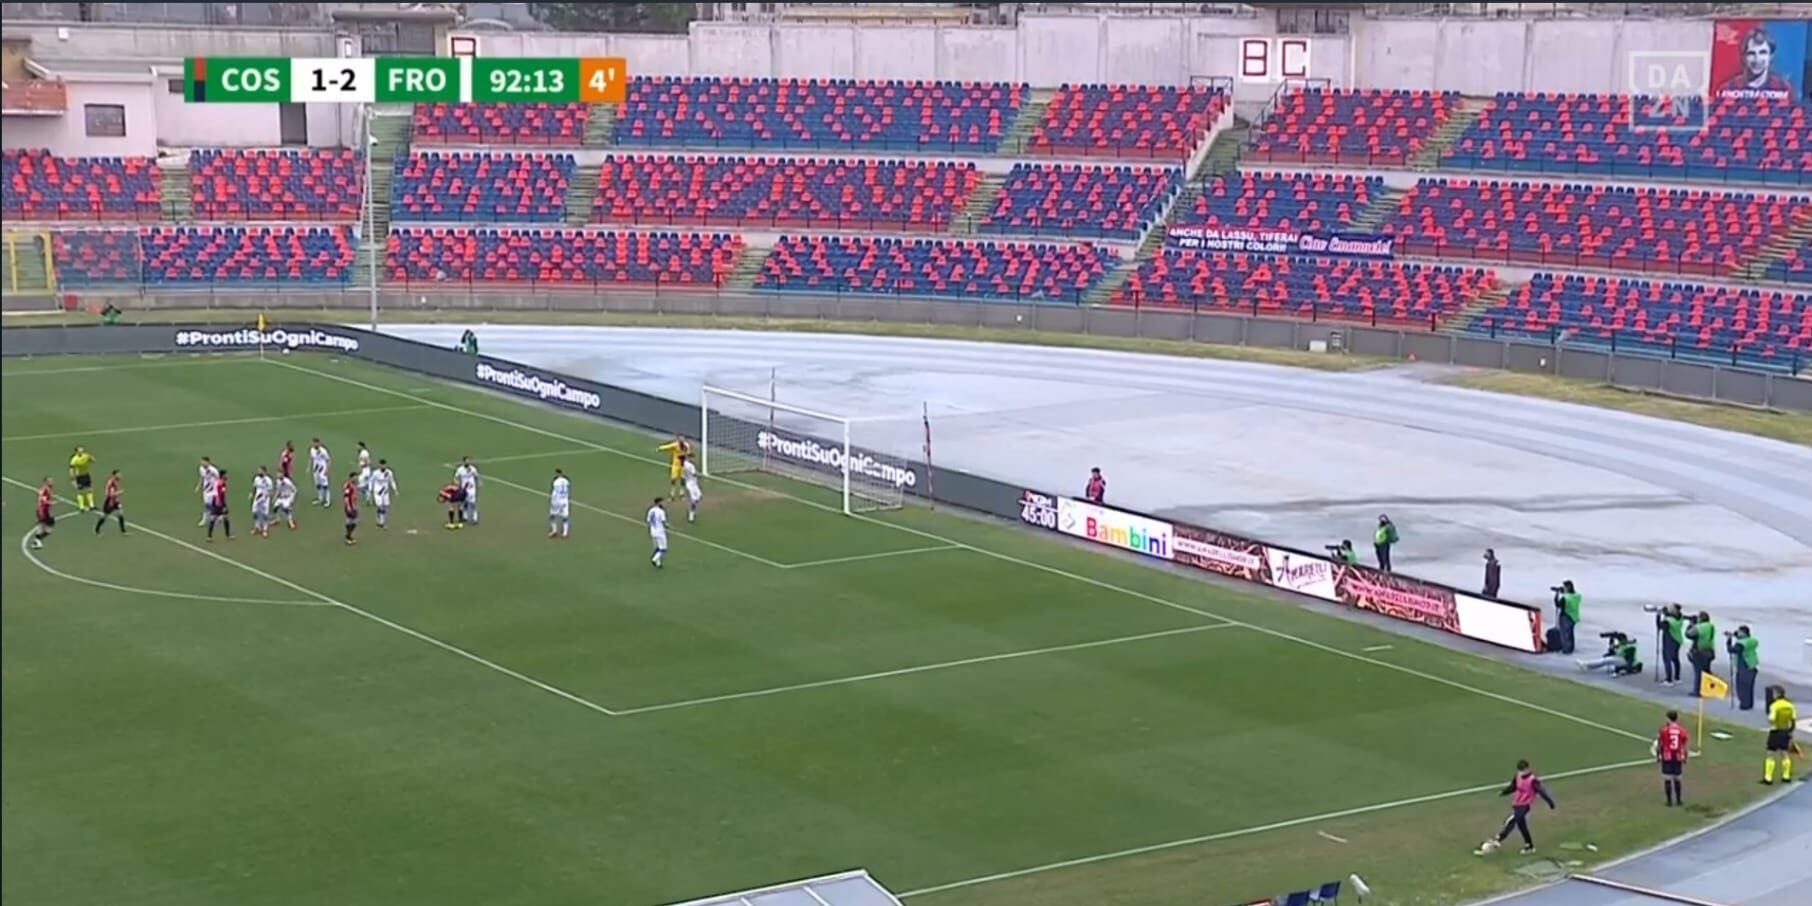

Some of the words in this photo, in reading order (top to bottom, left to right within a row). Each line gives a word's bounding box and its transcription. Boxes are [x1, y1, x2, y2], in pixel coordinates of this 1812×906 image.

[1169, 227, 1203, 239] ANCHE
[1205, 228, 1219, 239] DA
[1260, 231, 1299, 243] TIFERAI
[1179, 238, 1200, 248] PER
[1206, 239, 1245, 250] NOSTRI
[175, 329, 360, 351] #ProntiSuOgniCampo
[476, 362, 600, 409] #ProntiSuOgniCampo
[1021, 504, 1056, 528] 45:00
[1086, 515, 1167, 556] Bambini
[1669, 735, 1679, 750] 3
